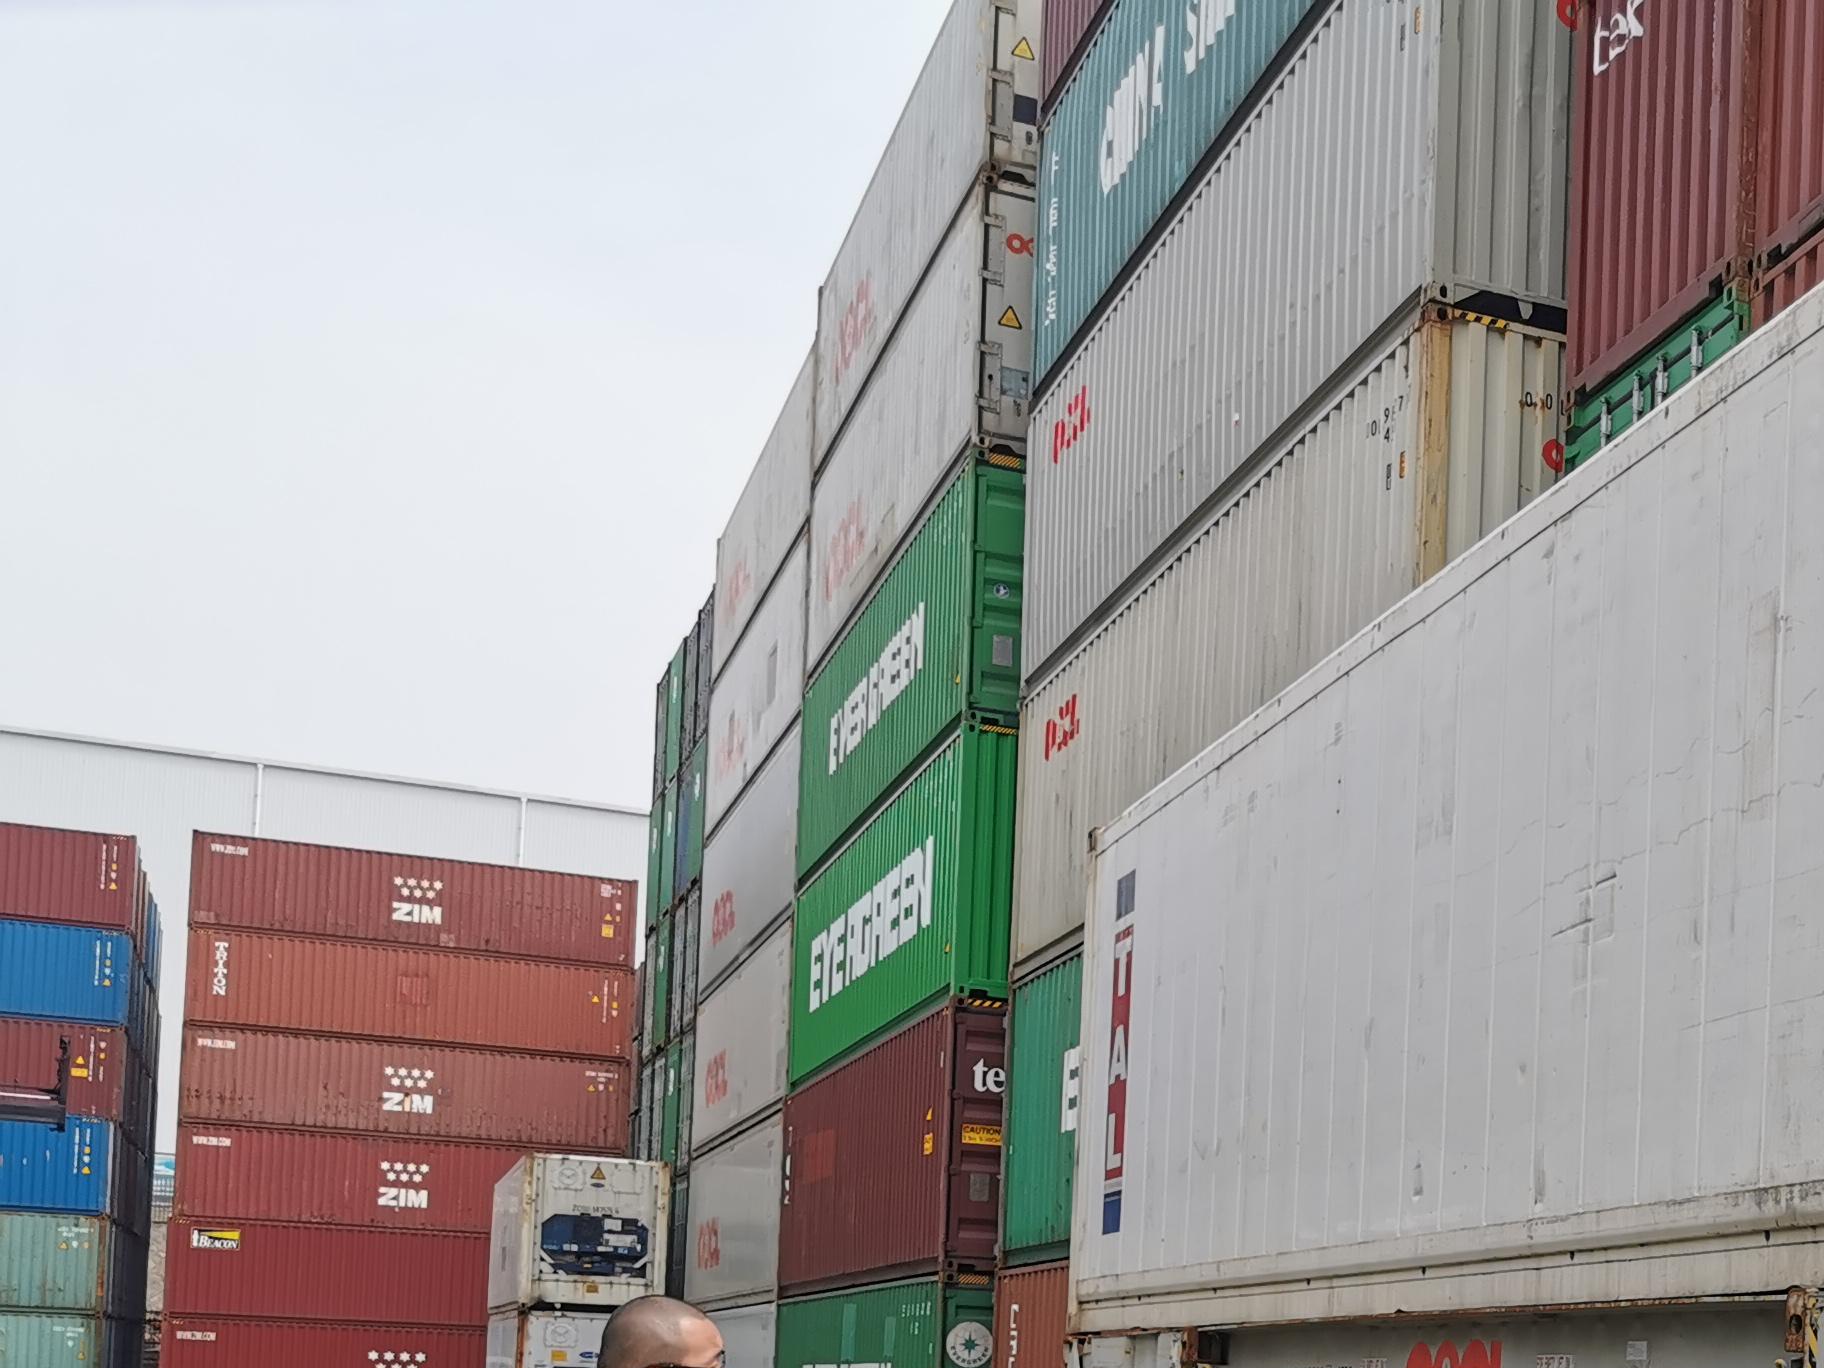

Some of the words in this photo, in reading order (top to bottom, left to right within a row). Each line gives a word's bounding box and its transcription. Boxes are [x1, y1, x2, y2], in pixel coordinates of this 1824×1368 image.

[829, 601, 925, 775] EVERGREEN
[392, 901, 442, 925] ZIM
[809, 835, 934, 1013] EVERGREEN
[212, 941, 229, 996] TRITON
[1106, 937, 1132, 1170] TAL
[972, 1058, 1006, 1093] te
[382, 1091, 433, 1114] ZIM
[377, 1186, 428, 1209] ZIM
[199, 1235, 238, 1250] BEACON
[950, 1345, 990, 1366] EVERGREEN
